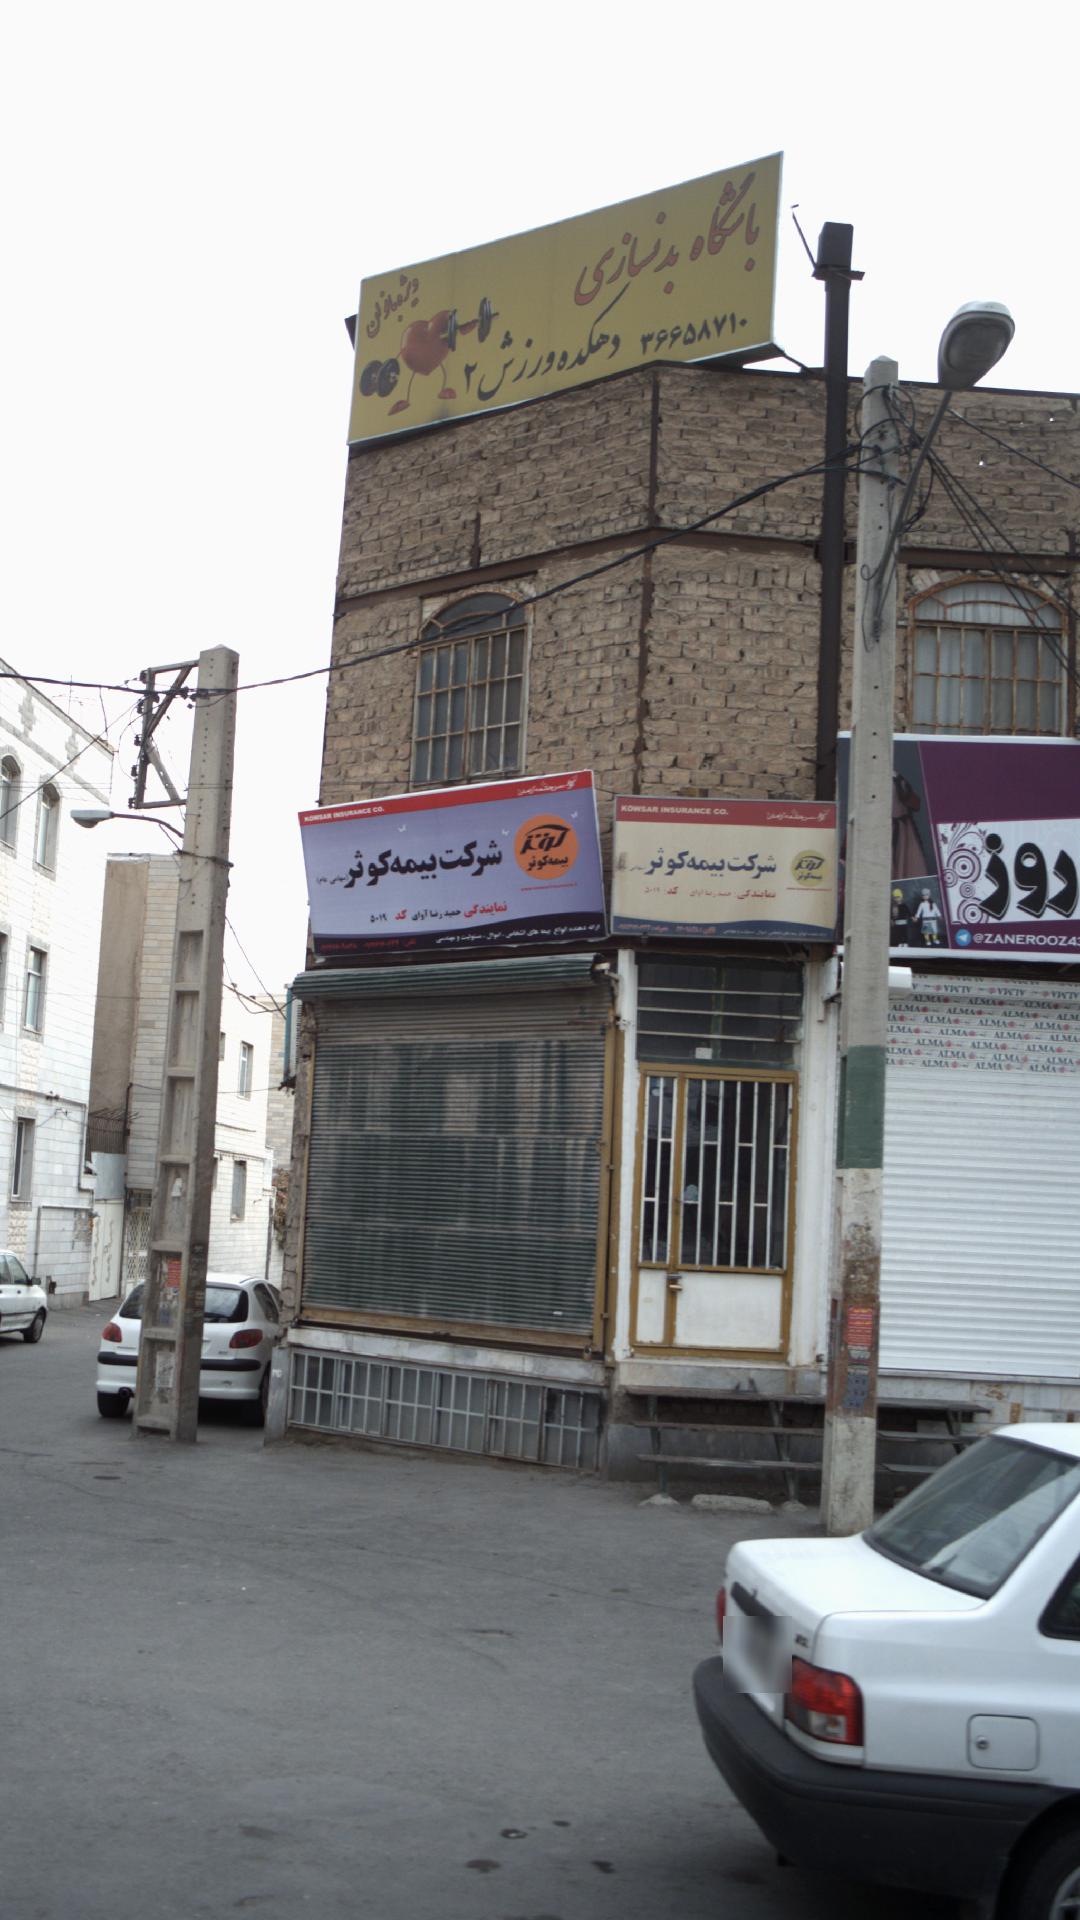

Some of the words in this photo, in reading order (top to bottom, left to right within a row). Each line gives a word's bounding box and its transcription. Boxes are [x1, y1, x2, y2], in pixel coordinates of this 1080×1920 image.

[640, 312, 748, 356] ۳۶۶۵۸۷۱۰
[621, 805, 659, 813] KOWSAR
[660, 806, 711, 815] INSURANCE
[344, 849, 392, 888] کوثر
[390, 853, 437, 880] بیمه
[439, 840, 503, 876] شرکت
[644, 848, 689, 875] کوثر
[687, 857, 725, 877] بیمه
[727, 854, 776, 879] شرکت
[976, 833, 1079, 921] روز
[1056, 1013, 1080, 1021] ALM
